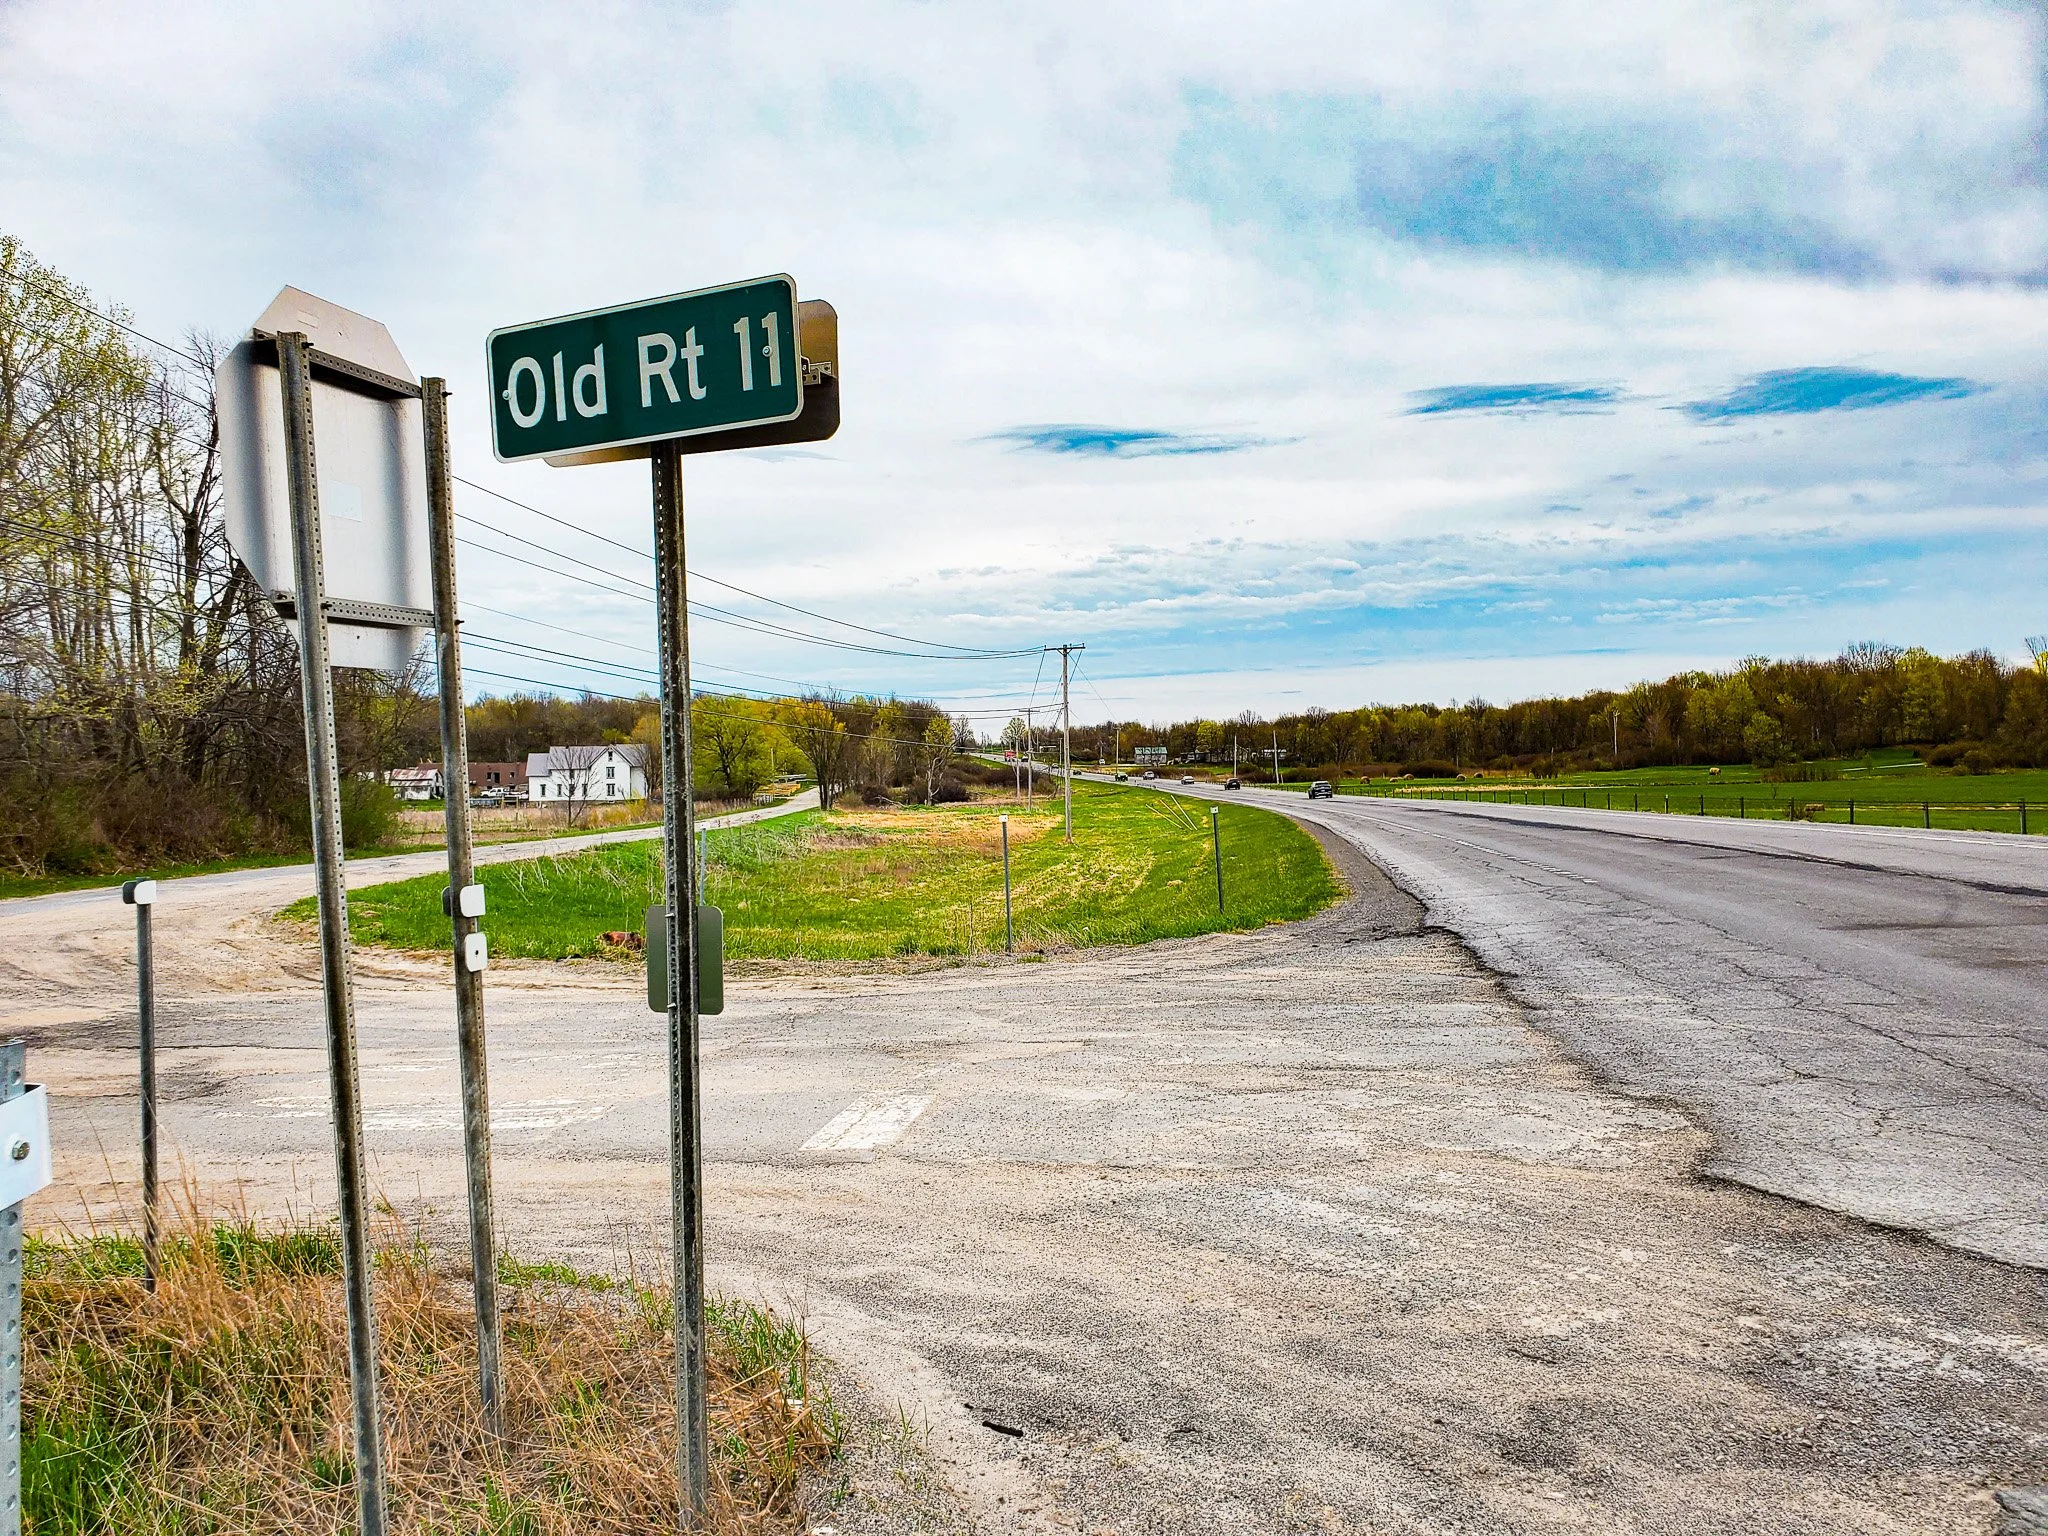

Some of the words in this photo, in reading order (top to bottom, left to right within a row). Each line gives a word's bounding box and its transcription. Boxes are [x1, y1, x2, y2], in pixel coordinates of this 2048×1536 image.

[507, 343, 608, 429] Old
[637, 325, 707, 408] Rt
[733, 311, 782, 392] 11
